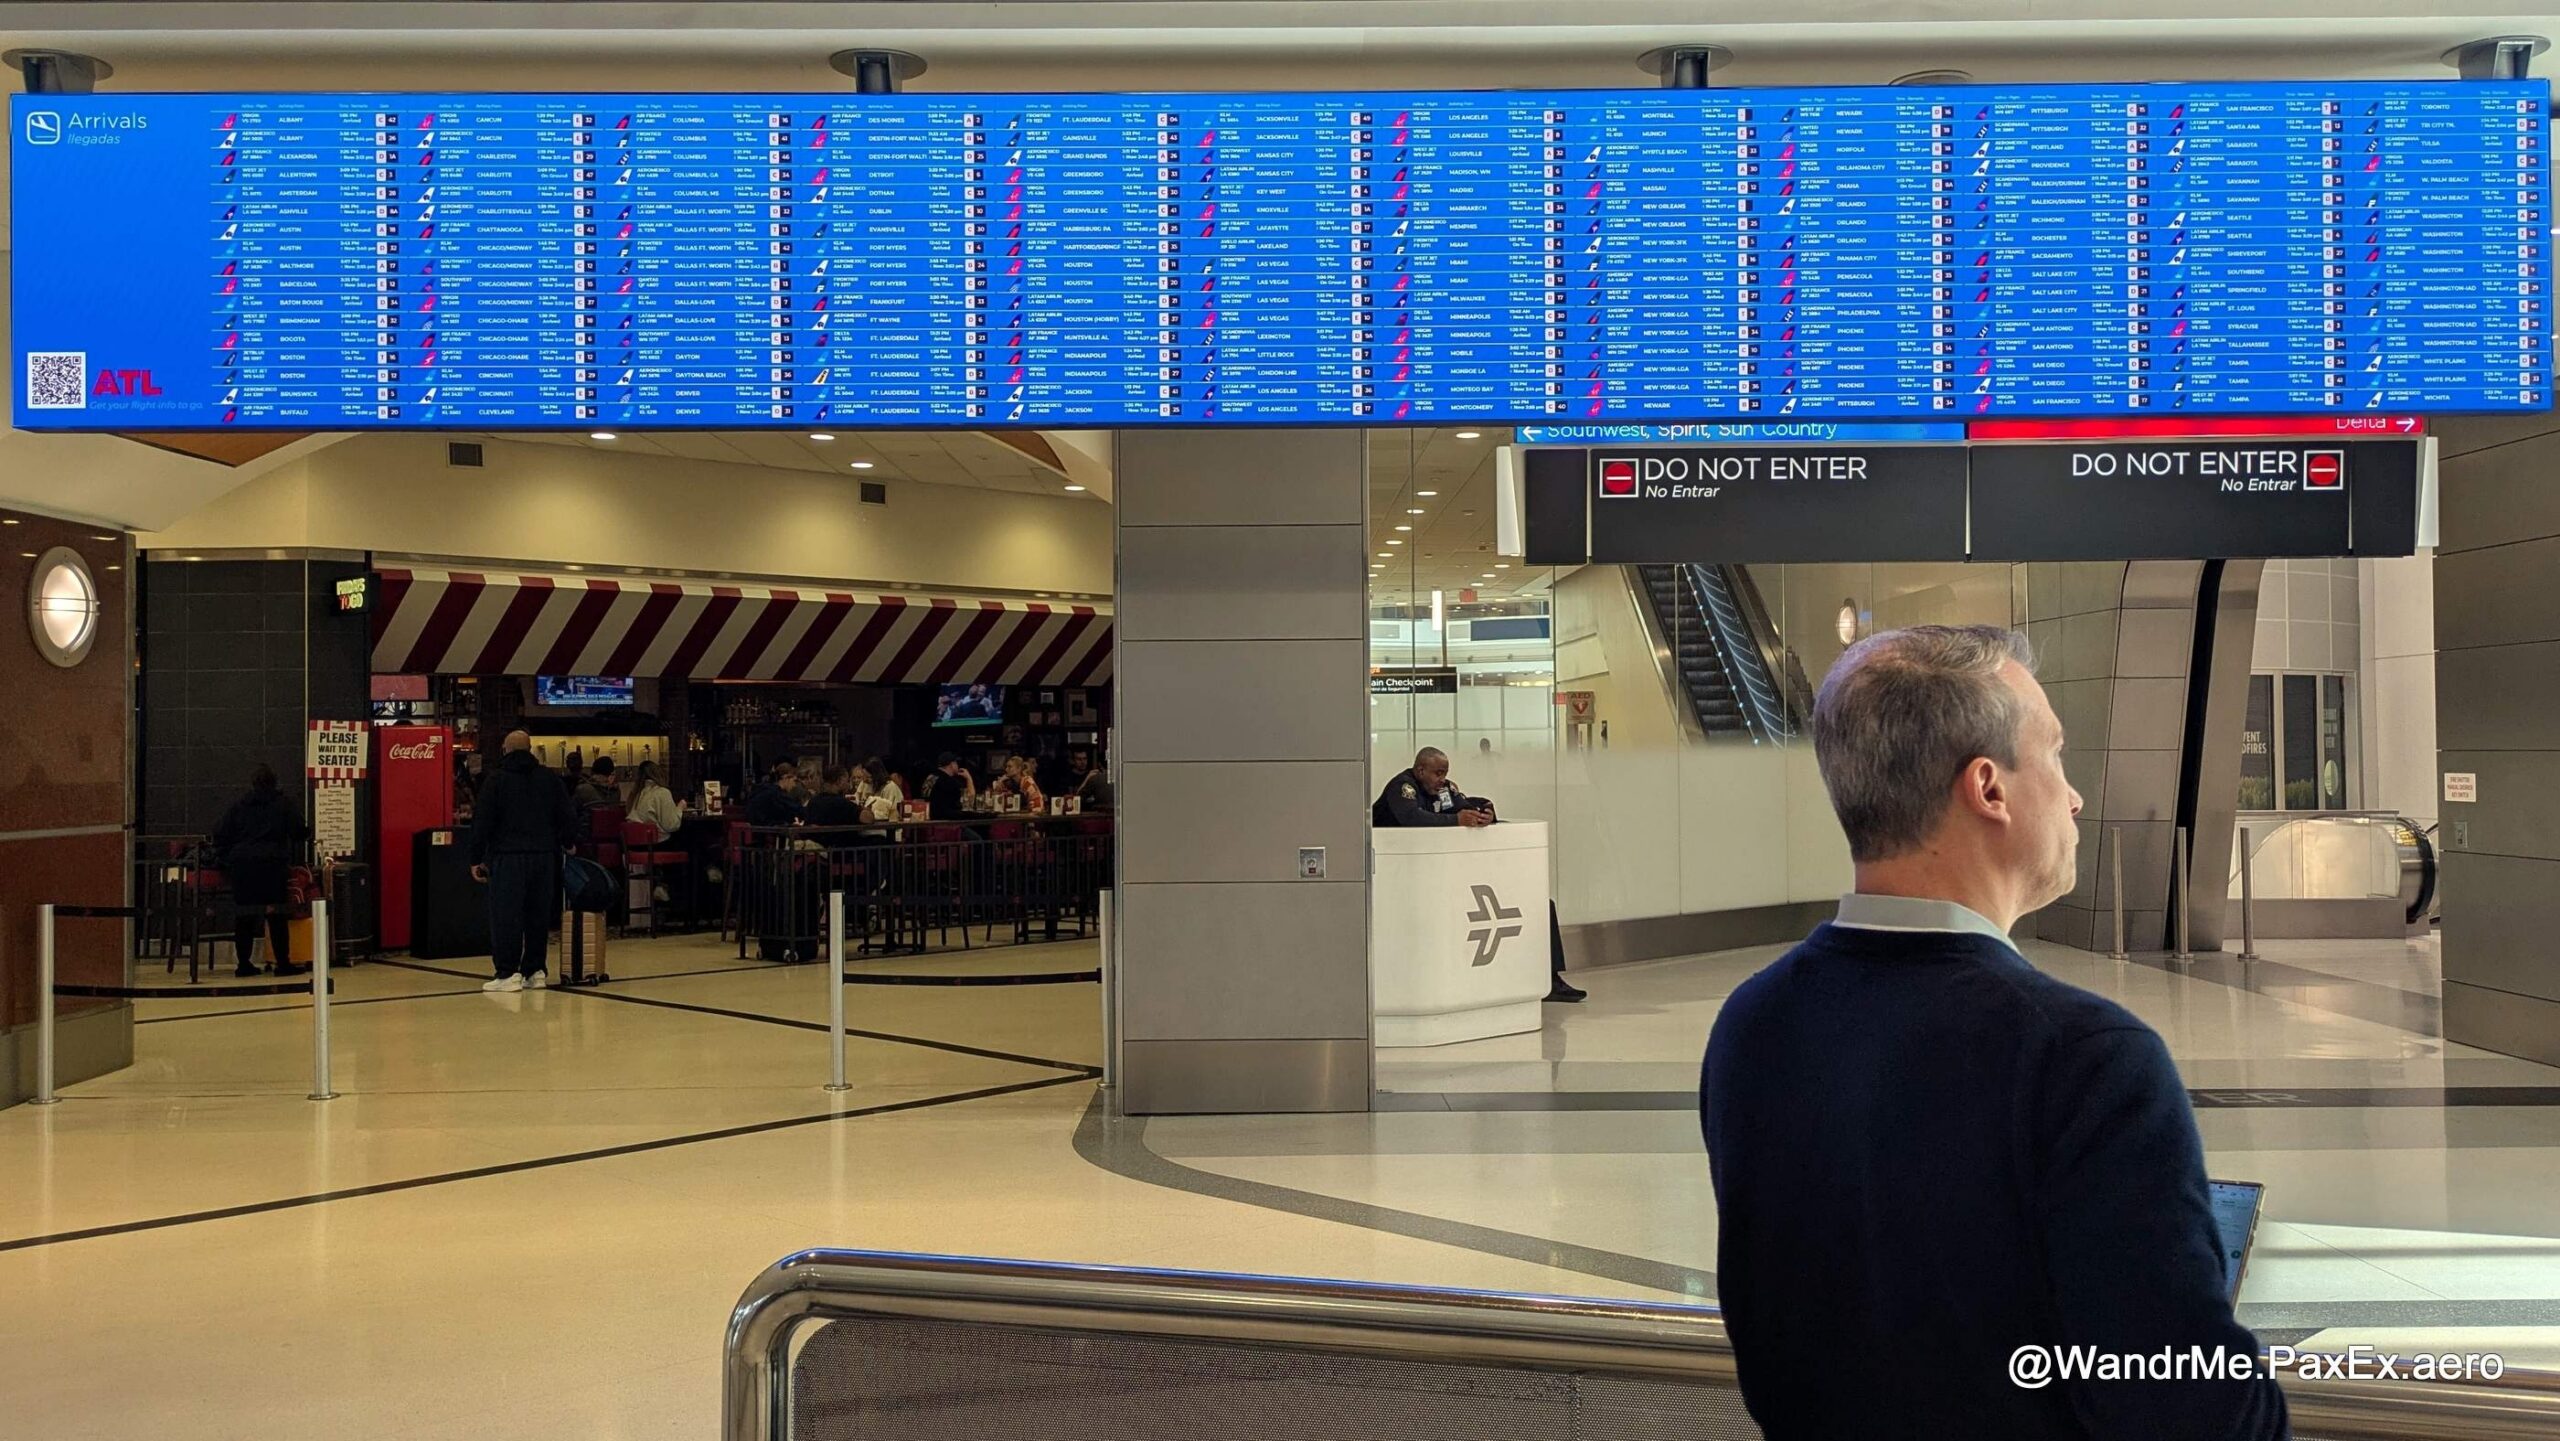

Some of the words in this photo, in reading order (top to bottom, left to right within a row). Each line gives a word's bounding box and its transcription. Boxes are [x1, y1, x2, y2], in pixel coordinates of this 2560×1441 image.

[68, 112, 147, 129] Arrivals
[67, 133, 121, 146] llegadas
[92, 369, 163, 396] ATL
[1645, 457, 1689, 481] DO
[1698, 457, 1761, 480] NOT
[1770, 457, 1867, 480] ENTER
[2072, 453, 2116, 476] DO
[2127, 452, 2190, 476] NOT
[2200, 451, 2297, 475] ENTER
[2221, 478, 2244, 492] No
[2247, 477, 2297, 491] Entrar
[1645, 485, 1668, 498] No
[1671, 485, 1720, 498] Entrar
[1371, 678, 1384, 687] ain
[319, 732, 358, 744] PLEASE
[318, 745, 336, 754] WAIT
[338, 745, 347, 754] TO
[349, 745, 358, 754] BE
[318, 754, 357, 766] SEATED
